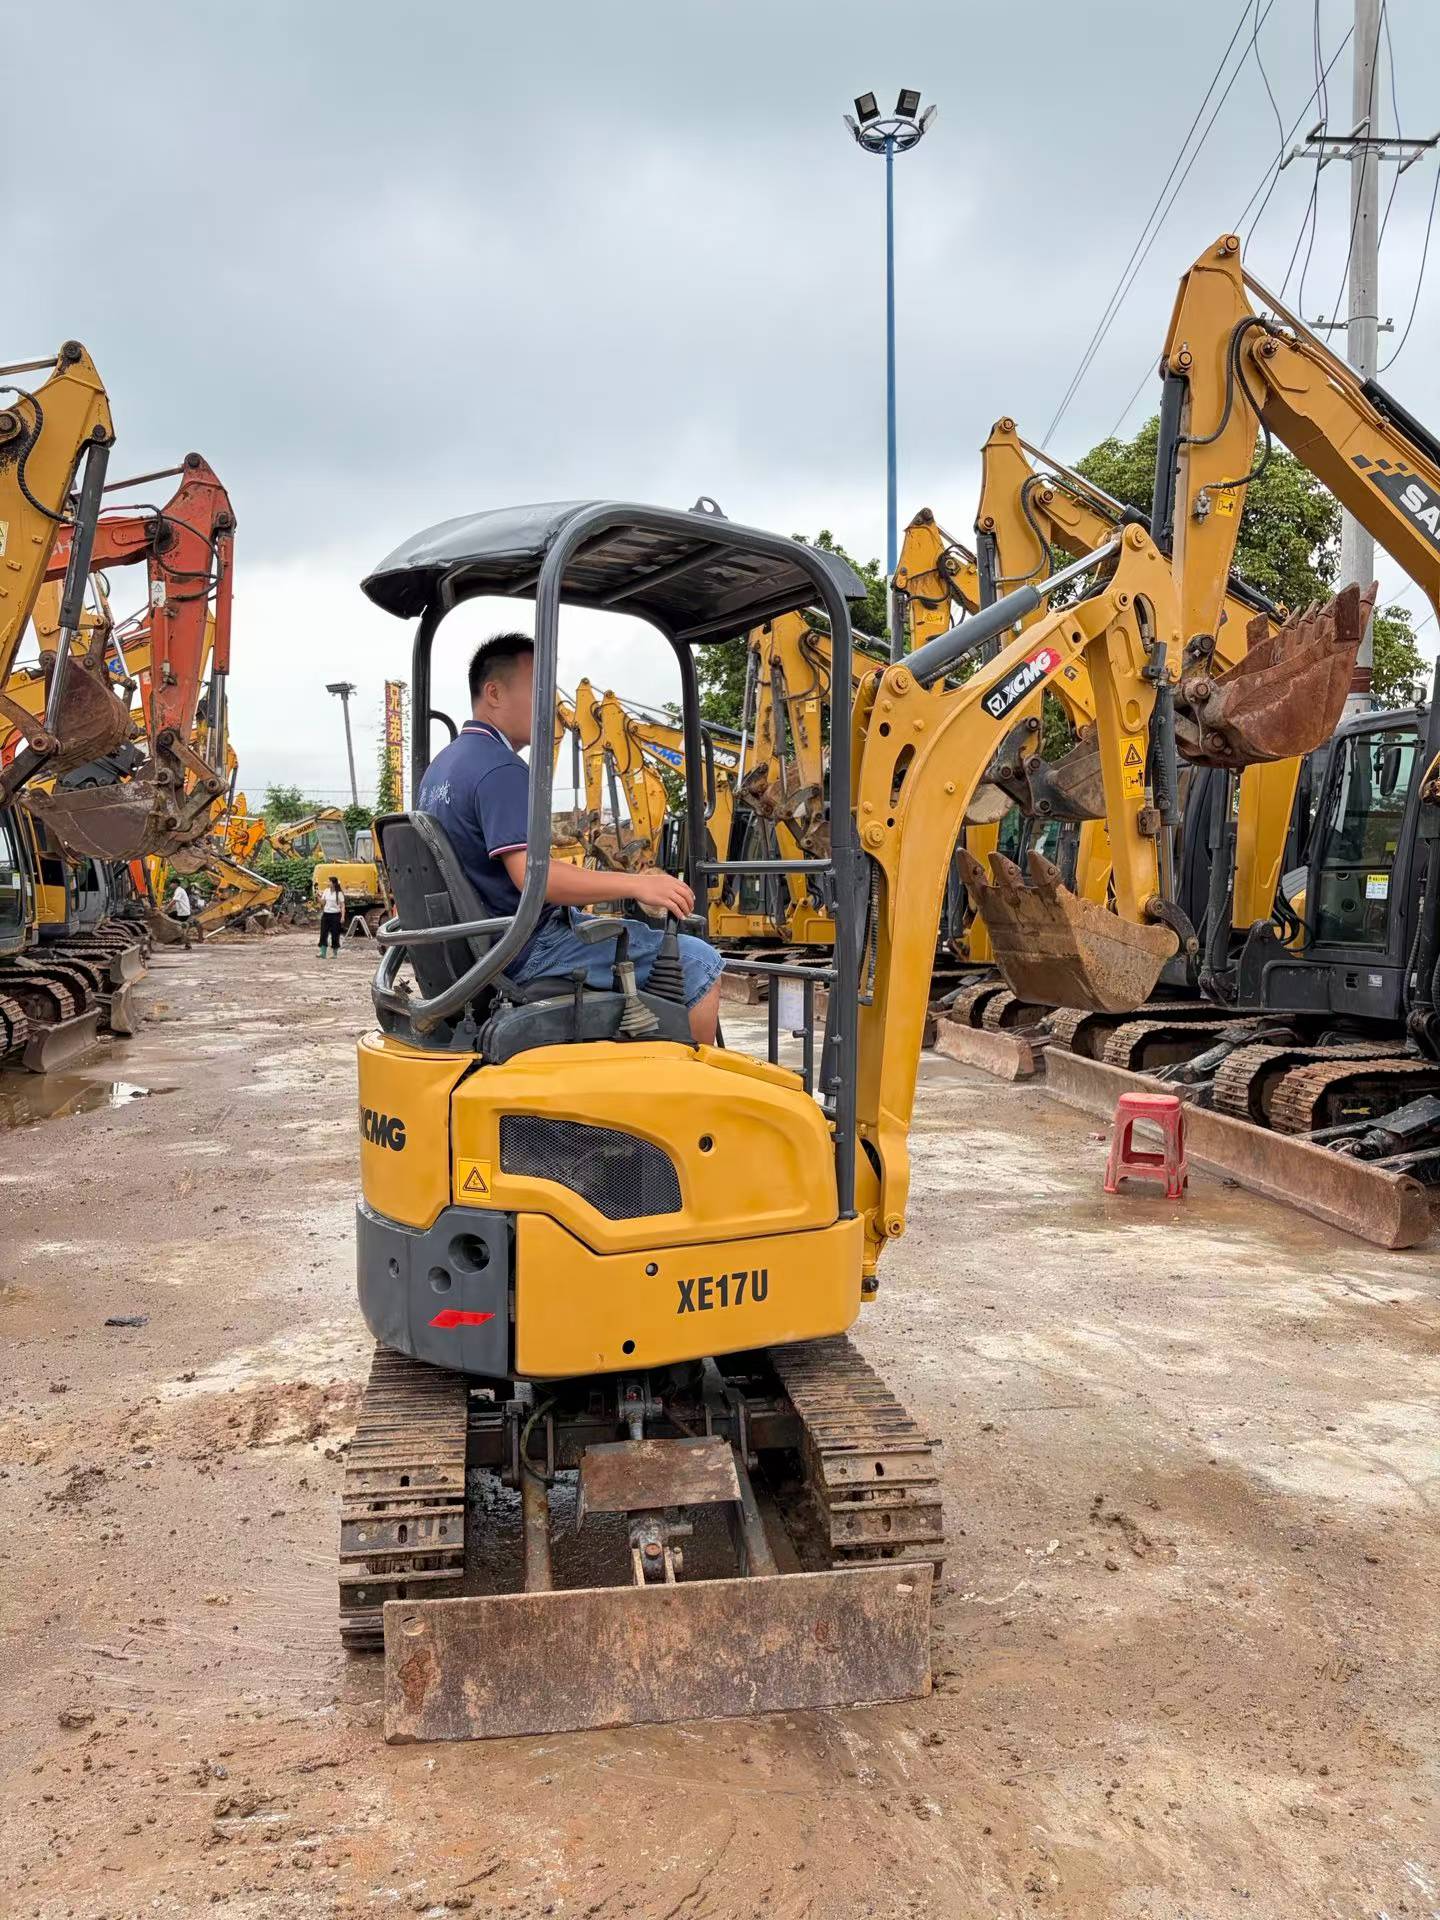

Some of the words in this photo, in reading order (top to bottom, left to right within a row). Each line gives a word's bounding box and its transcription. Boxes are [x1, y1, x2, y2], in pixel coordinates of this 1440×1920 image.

[1399, 484, 1440, 540] SA
[1002, 651, 1051, 706] XCMG
[677, 1269, 768, 1314] XE17U
